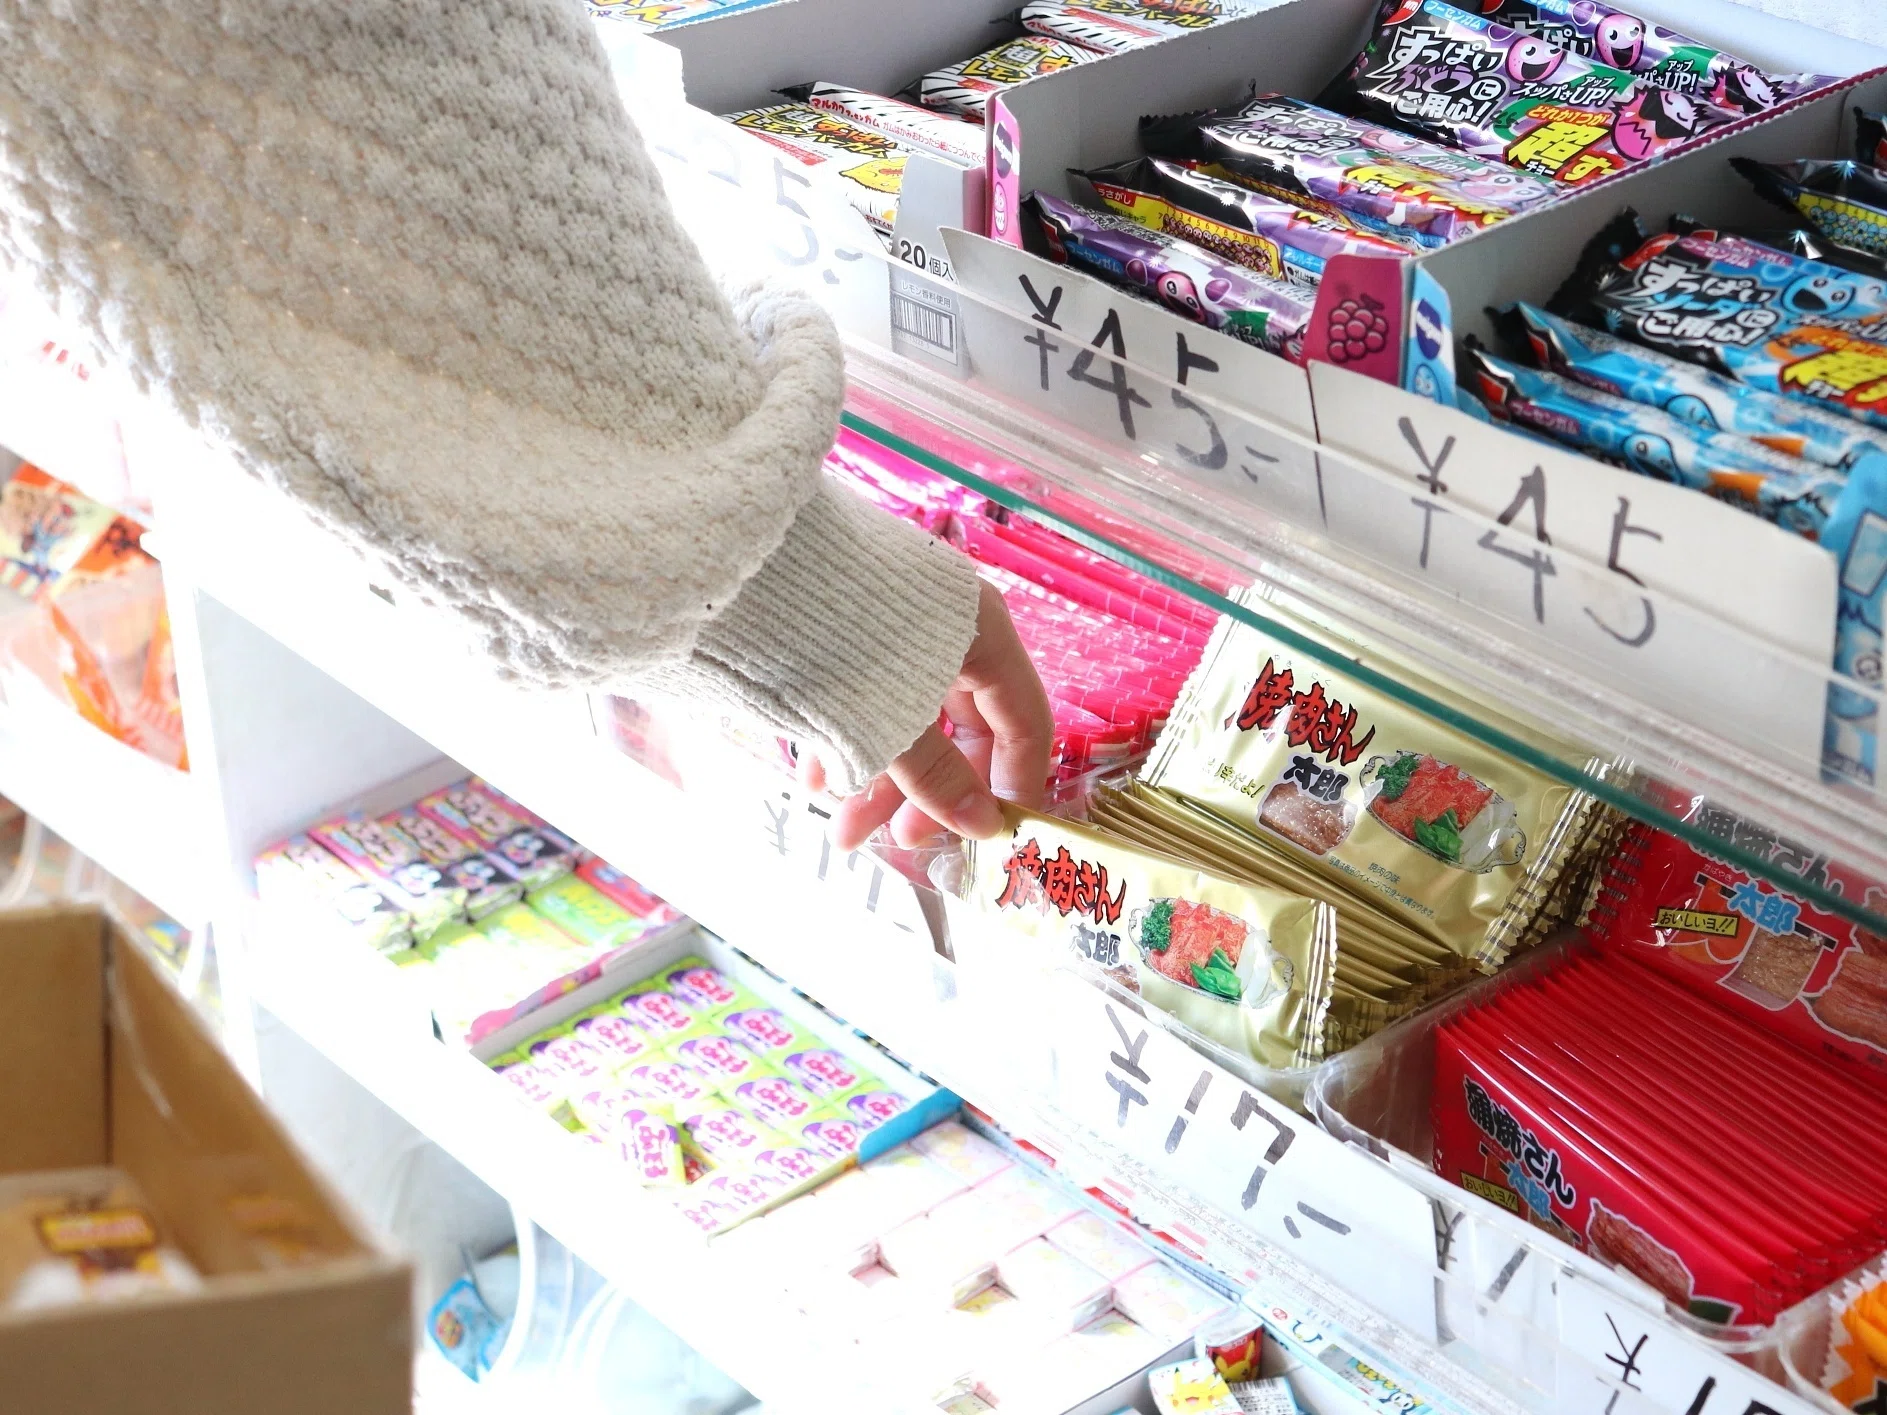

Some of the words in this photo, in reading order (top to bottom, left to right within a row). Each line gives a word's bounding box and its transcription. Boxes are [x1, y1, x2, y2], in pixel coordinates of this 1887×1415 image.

[1425, 0, 1484, 30] フーセンガム
[1395, 33, 1499, 69] すっぱい
[1581, 75, 1616, 87] アップ
[1396, 90, 1492, 123] ご用心!
[902, 281, 952, 309] レモン香料使用
[1398, 416, 1663, 647] ¥45
[1283, 755, 1349, 802] 太郎
[1727, 880, 1800, 935] 太郎
